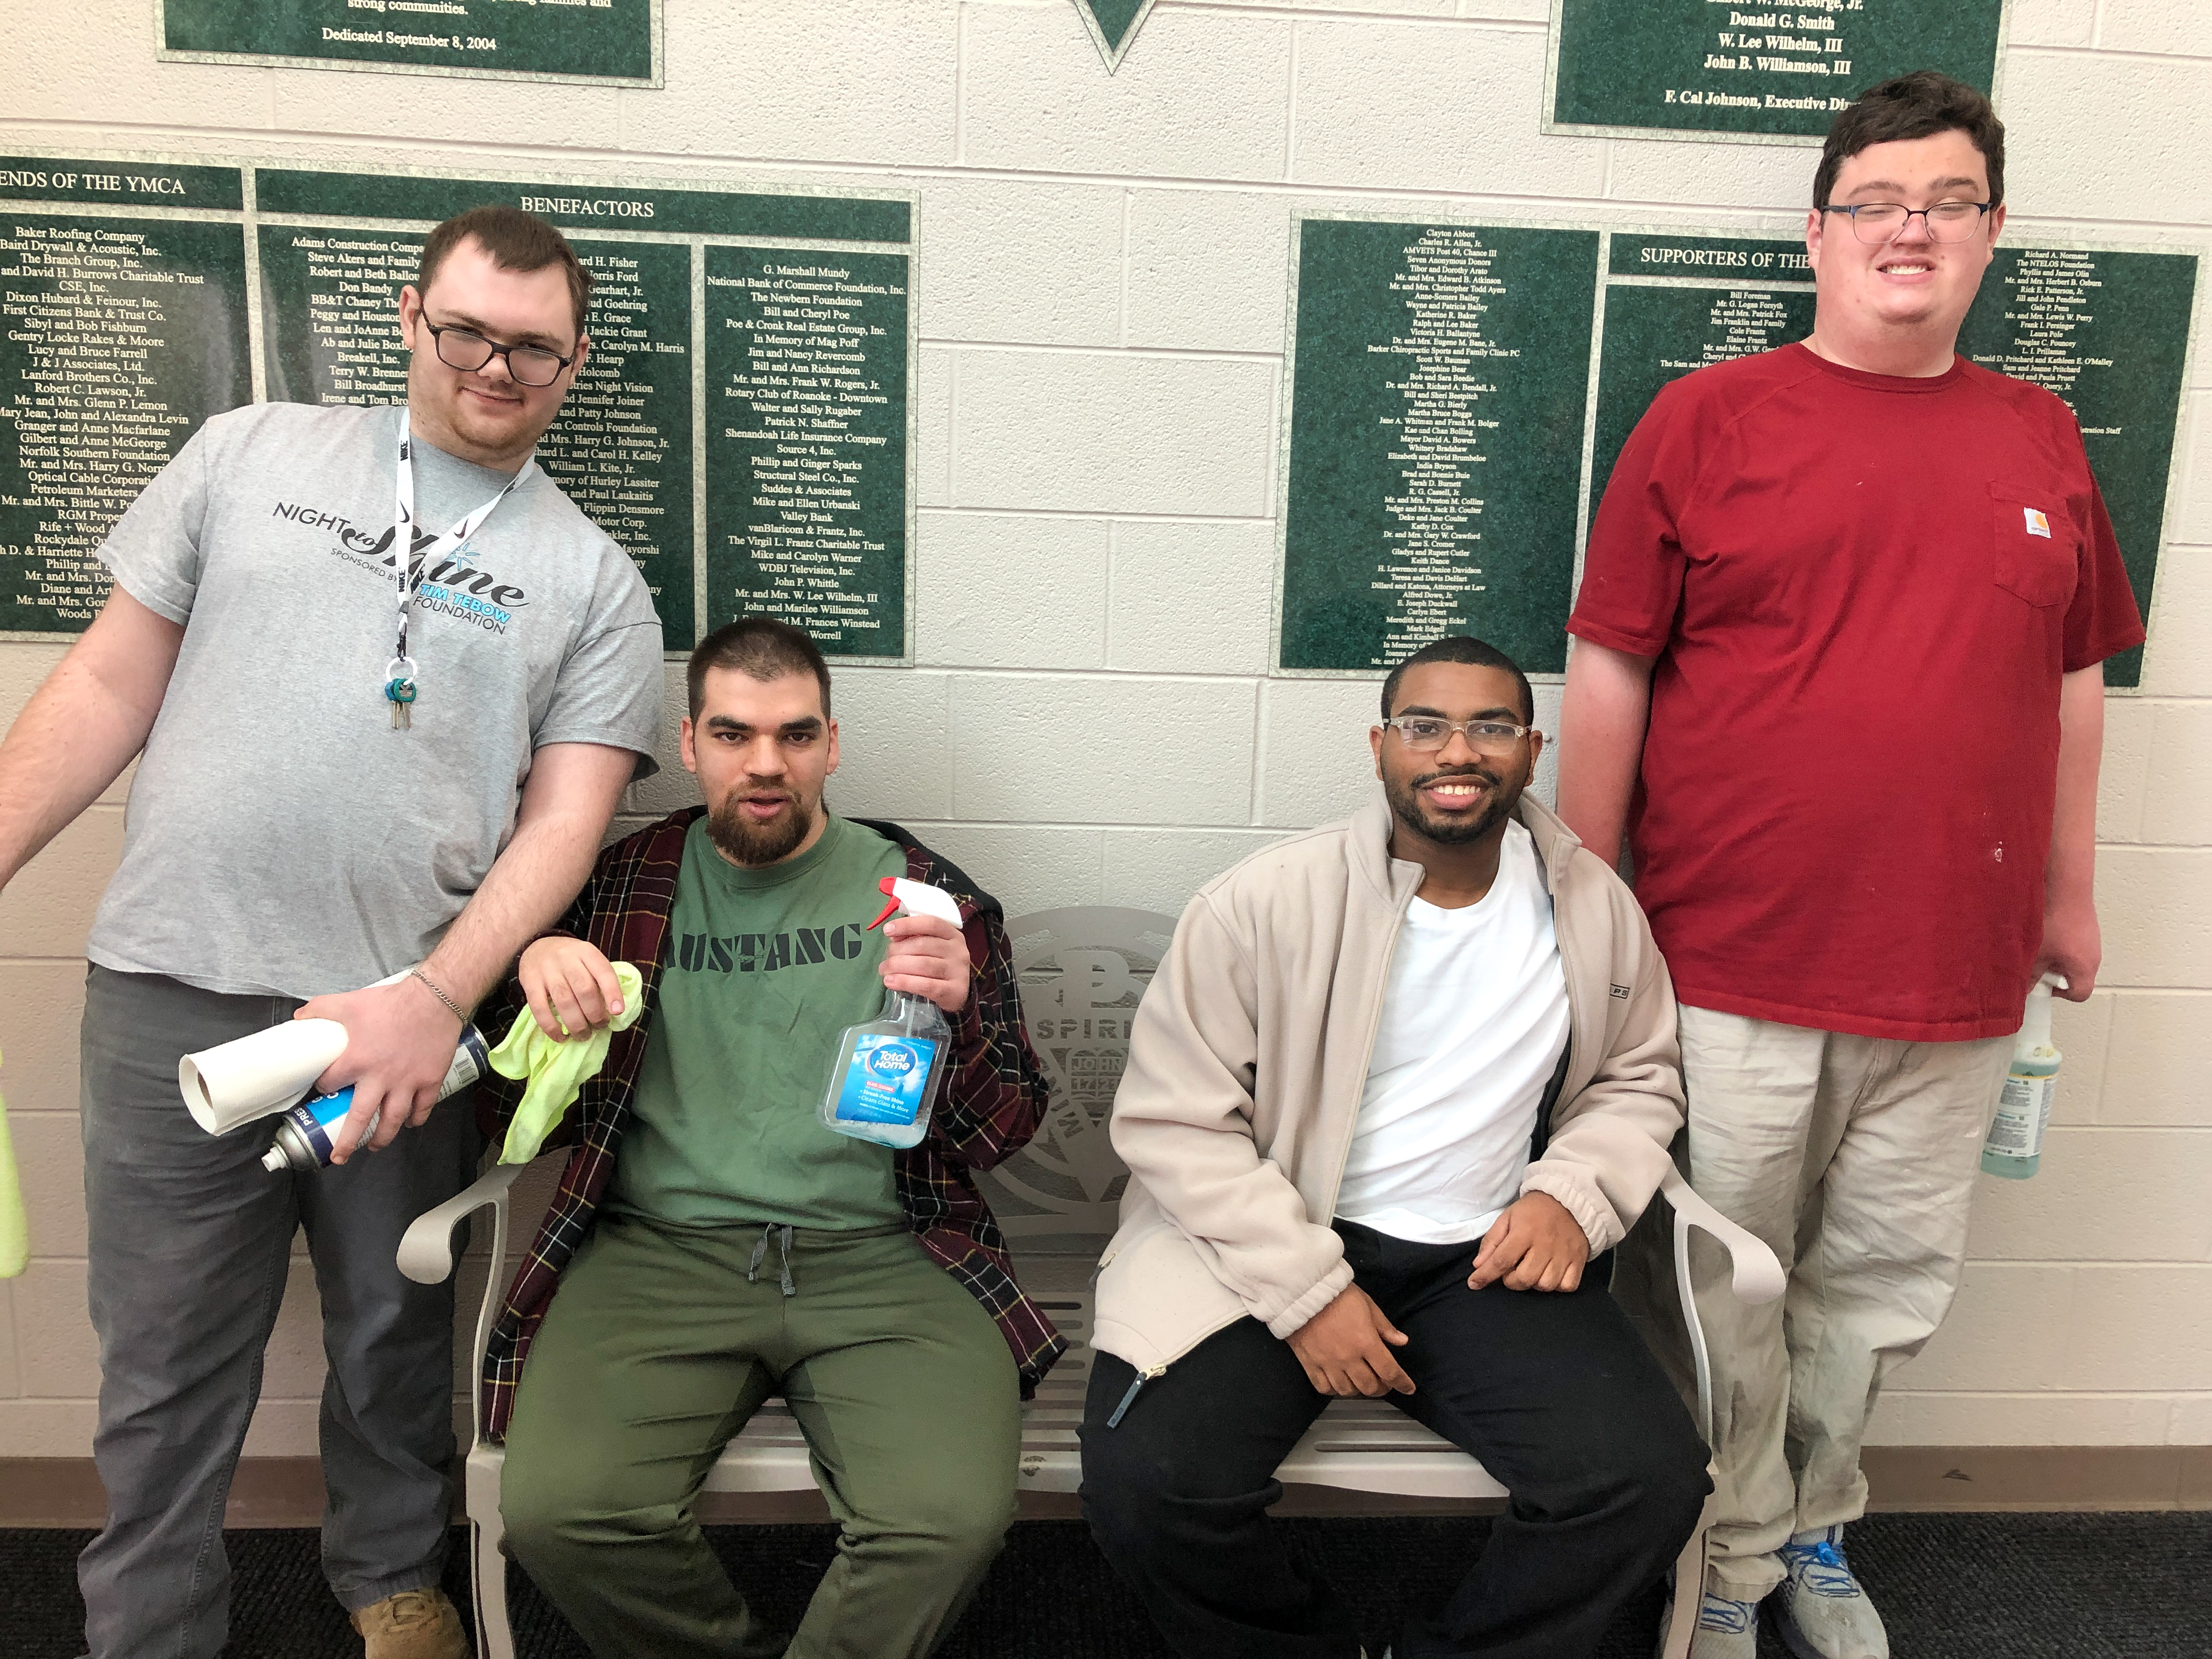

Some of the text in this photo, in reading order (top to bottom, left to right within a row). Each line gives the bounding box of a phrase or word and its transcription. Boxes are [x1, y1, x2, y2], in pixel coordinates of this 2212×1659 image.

[388, 1, 468, 15] communities.
[1729, 12, 1835, 30] Donald G. Smith
[322, 27, 496, 50] Dedicated September 8, 2004
[1718, 33, 1843, 54] W. Lee Wilhelm, III
[1704, 54, 1852, 76] John B. Williamson, III
[1664, 90, 1676, 103] F.
[1680, 91, 1702, 104] Cal
[1705, 92, 1761, 109] Johnson,
[1764, 95, 1826, 110] Executive
[52, 173, 77, 188] OF
[82, 174, 121, 190] THE
[125, 176, 185, 194] YMCA
[521, 197, 654, 217] BENEFACTORS
[15, 227, 145, 244] Baker Roofing Company
[1426, 229, 1451, 238] Clayton
[20, 253, 143, 269] The Branch Group, Inc.
[308, 251, 421, 269] Steve Akers and Family
[1428, 257, 1466, 266] Anonymous
[1641, 248, 1747, 266] SUPPORTERS
[1752, 252, 1774, 267] OF
[764, 265, 850, 280] G. Marshall Mundy
[59, 281, 109, 293] CSE, Inc.
[339, 281, 392, 296] Don Bandy
[6, 291, 161, 308] Dixon Hubard & Feinour, Inc.
[751, 292, 862, 306] The Newbern Foundation
[25, 318, 147, 332] Sibyl and Bob Fishburn
[2015, 338, 2040, 347] Douglas
[337, 352, 400, 364] Breakell, Inc.
[1419, 365, 1450, 373] Josephine
[21, 370, 157, 385] Lanford Brothers Co., Inc.
[334, 379, 406, 391] Bill Broadhurst
[559, 408, 641, 420] and Patty Johnson
[751, 402, 862, 417] Walter and Sally Rugaber
[765, 416, 848, 428] Patrick N. Shaffner
[19, 445, 170, 461] Norfolk Southern Foundation
[777, 444, 836, 456] Source 4, Inc.
[549, 461, 635, 474] William L. Kite, Jr.
[761, 484, 851, 496] Suddes & Associates
[273, 502, 351, 534] NIGHT
[622, 517, 647, 529] Corp.
[780, 511, 833, 523] Valley Bank
[1411, 523, 1430, 531] Kathy
[330, 548, 386, 577] SPONSORED
[758, 563, 855, 576] WDBJ Television, Inc.
[419, 583, 512, 624] TIM TEBOW
[413, 596, 506, 635] FOUNDATION
[880, 1050, 909, 1062] Total
[874, 1059, 911, 1070] Home
